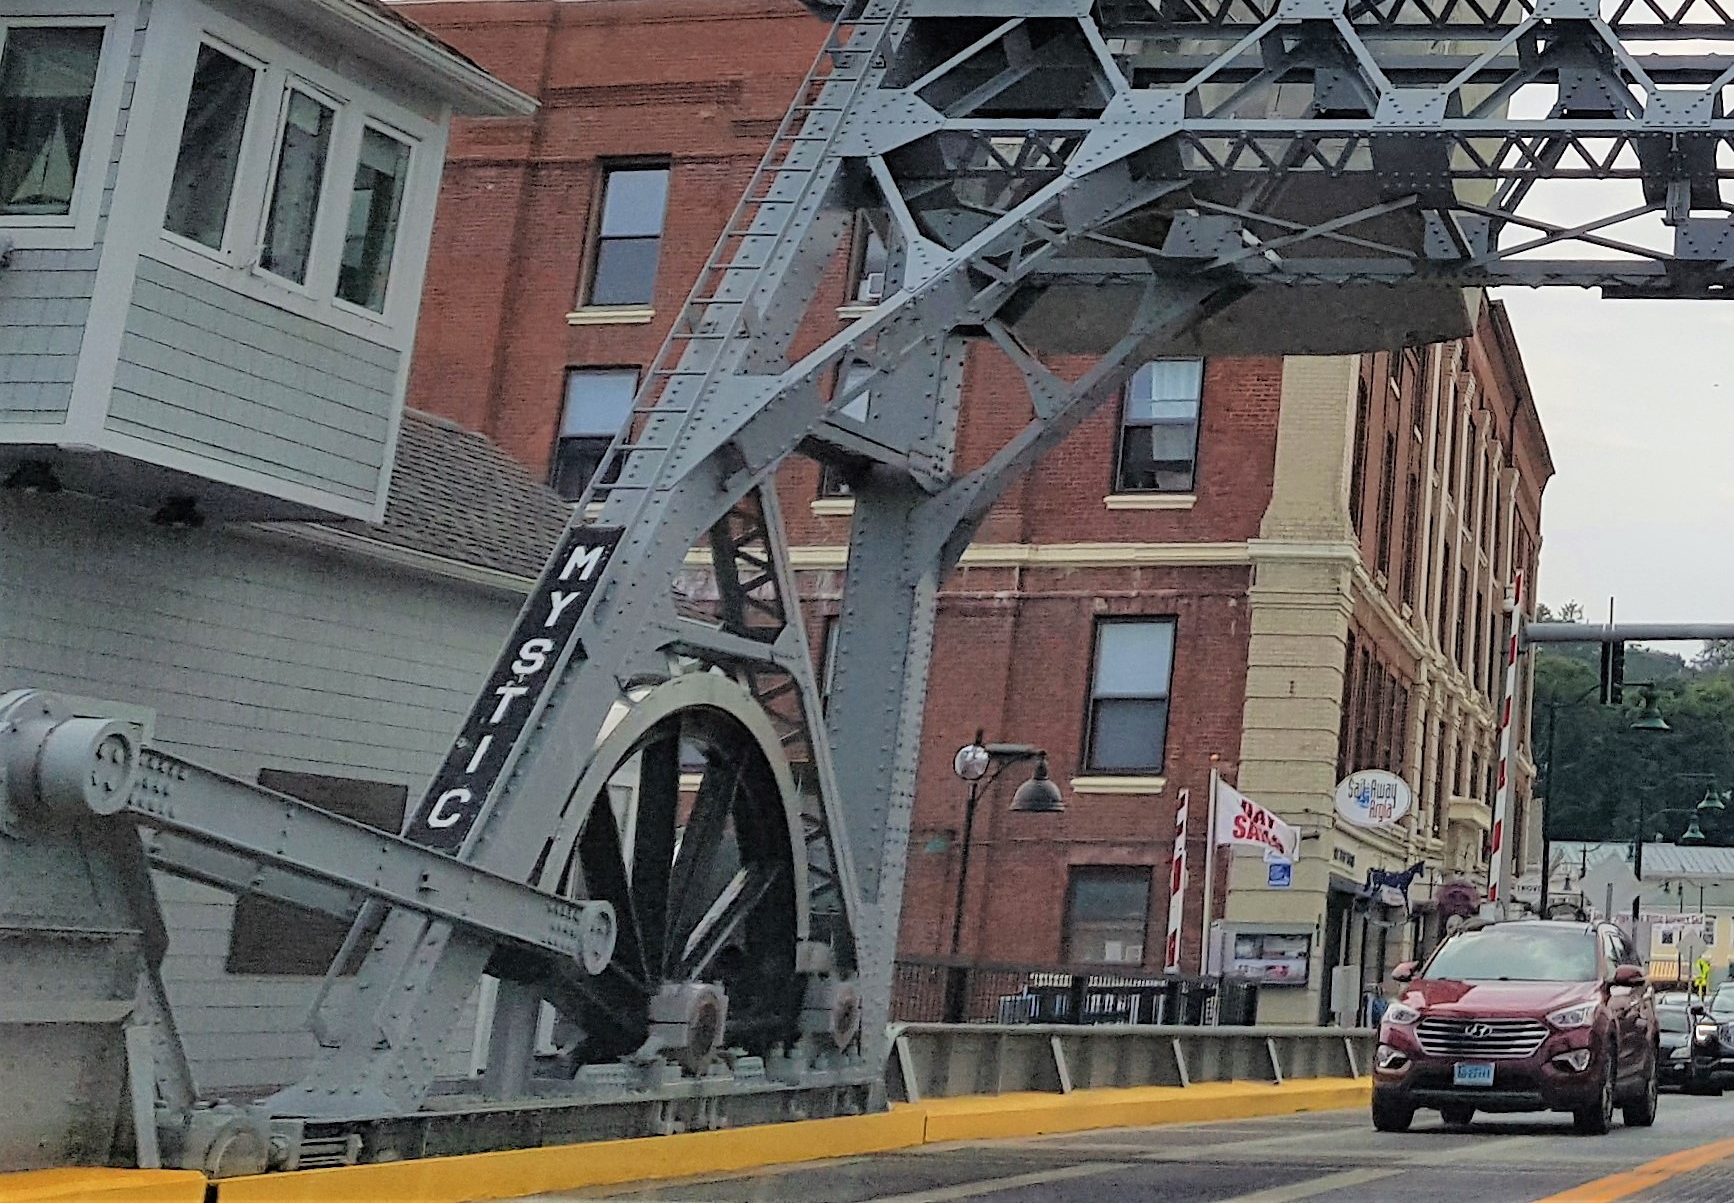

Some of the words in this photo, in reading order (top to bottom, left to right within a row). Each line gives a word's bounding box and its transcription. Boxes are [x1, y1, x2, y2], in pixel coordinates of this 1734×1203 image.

[427, 545, 604, 828] MYSTIC
[1348, 777, 1367, 799] Sail
[1370, 779, 1398, 809] Away
